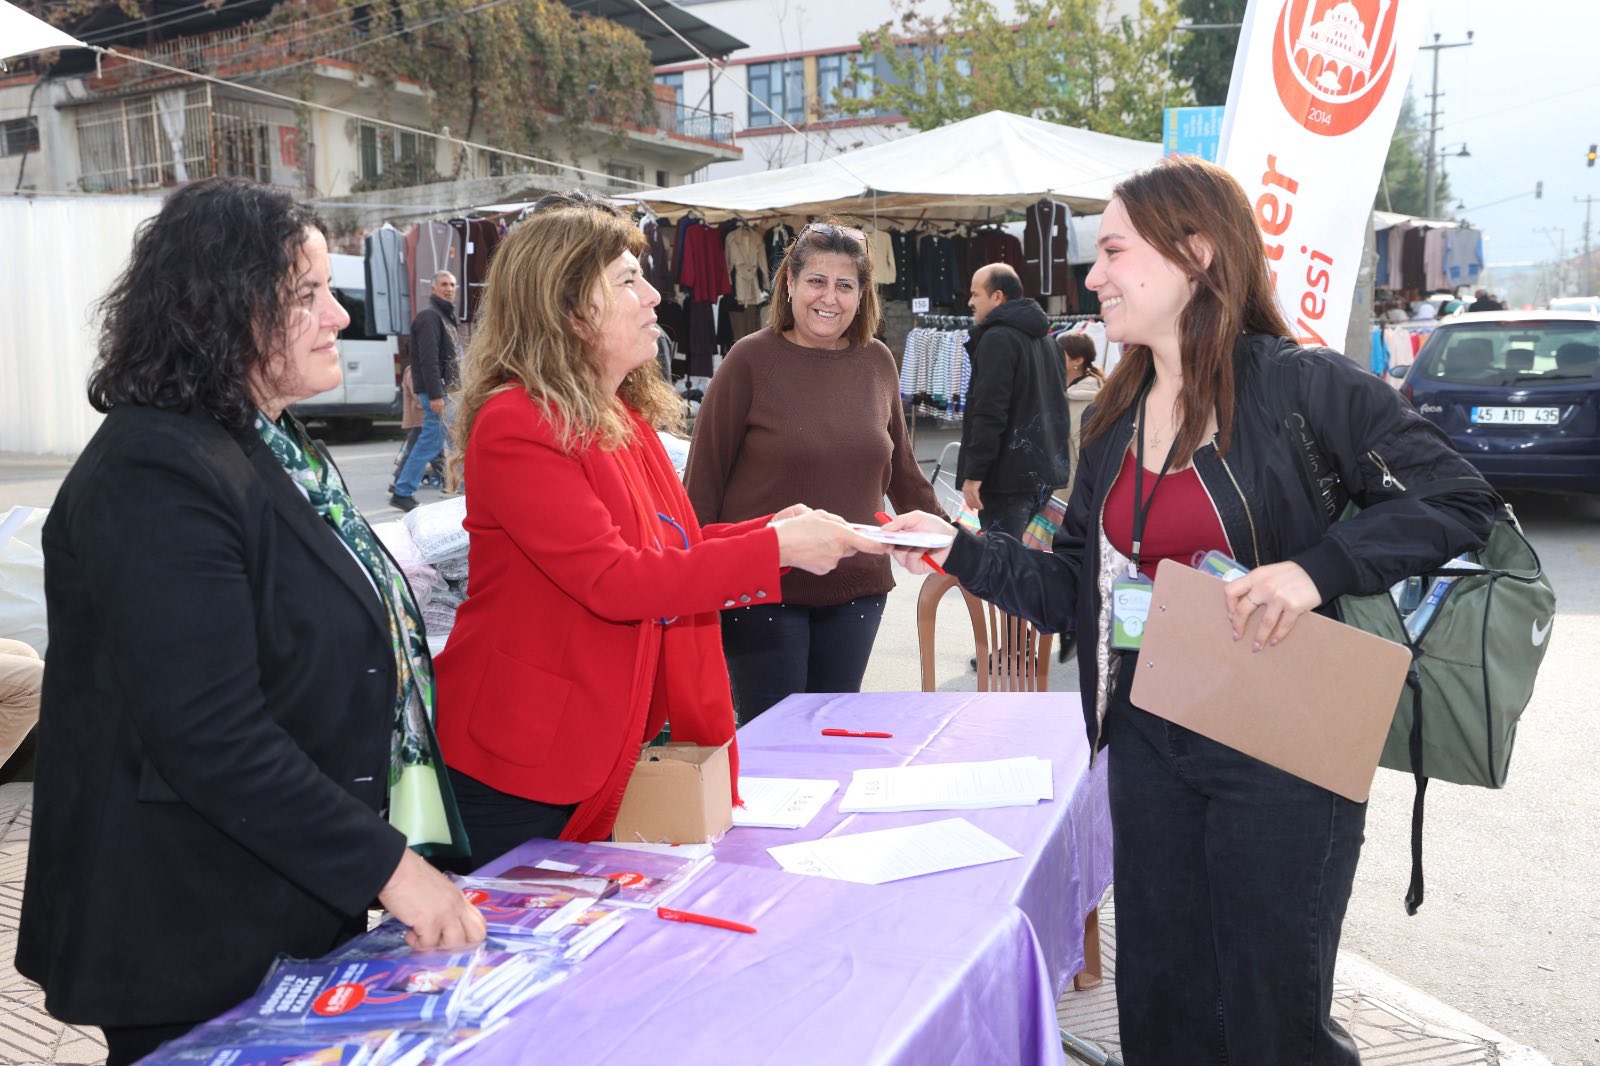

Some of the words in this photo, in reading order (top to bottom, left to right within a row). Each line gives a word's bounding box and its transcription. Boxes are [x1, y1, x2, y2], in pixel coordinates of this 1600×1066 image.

[1308, 107, 1332, 125] 2014
[914, 300, 927, 309] 150
[1477, 409, 1492, 421] 45
[1503, 409, 1525, 422] ATD
[1535, 409, 1558, 422] 435
